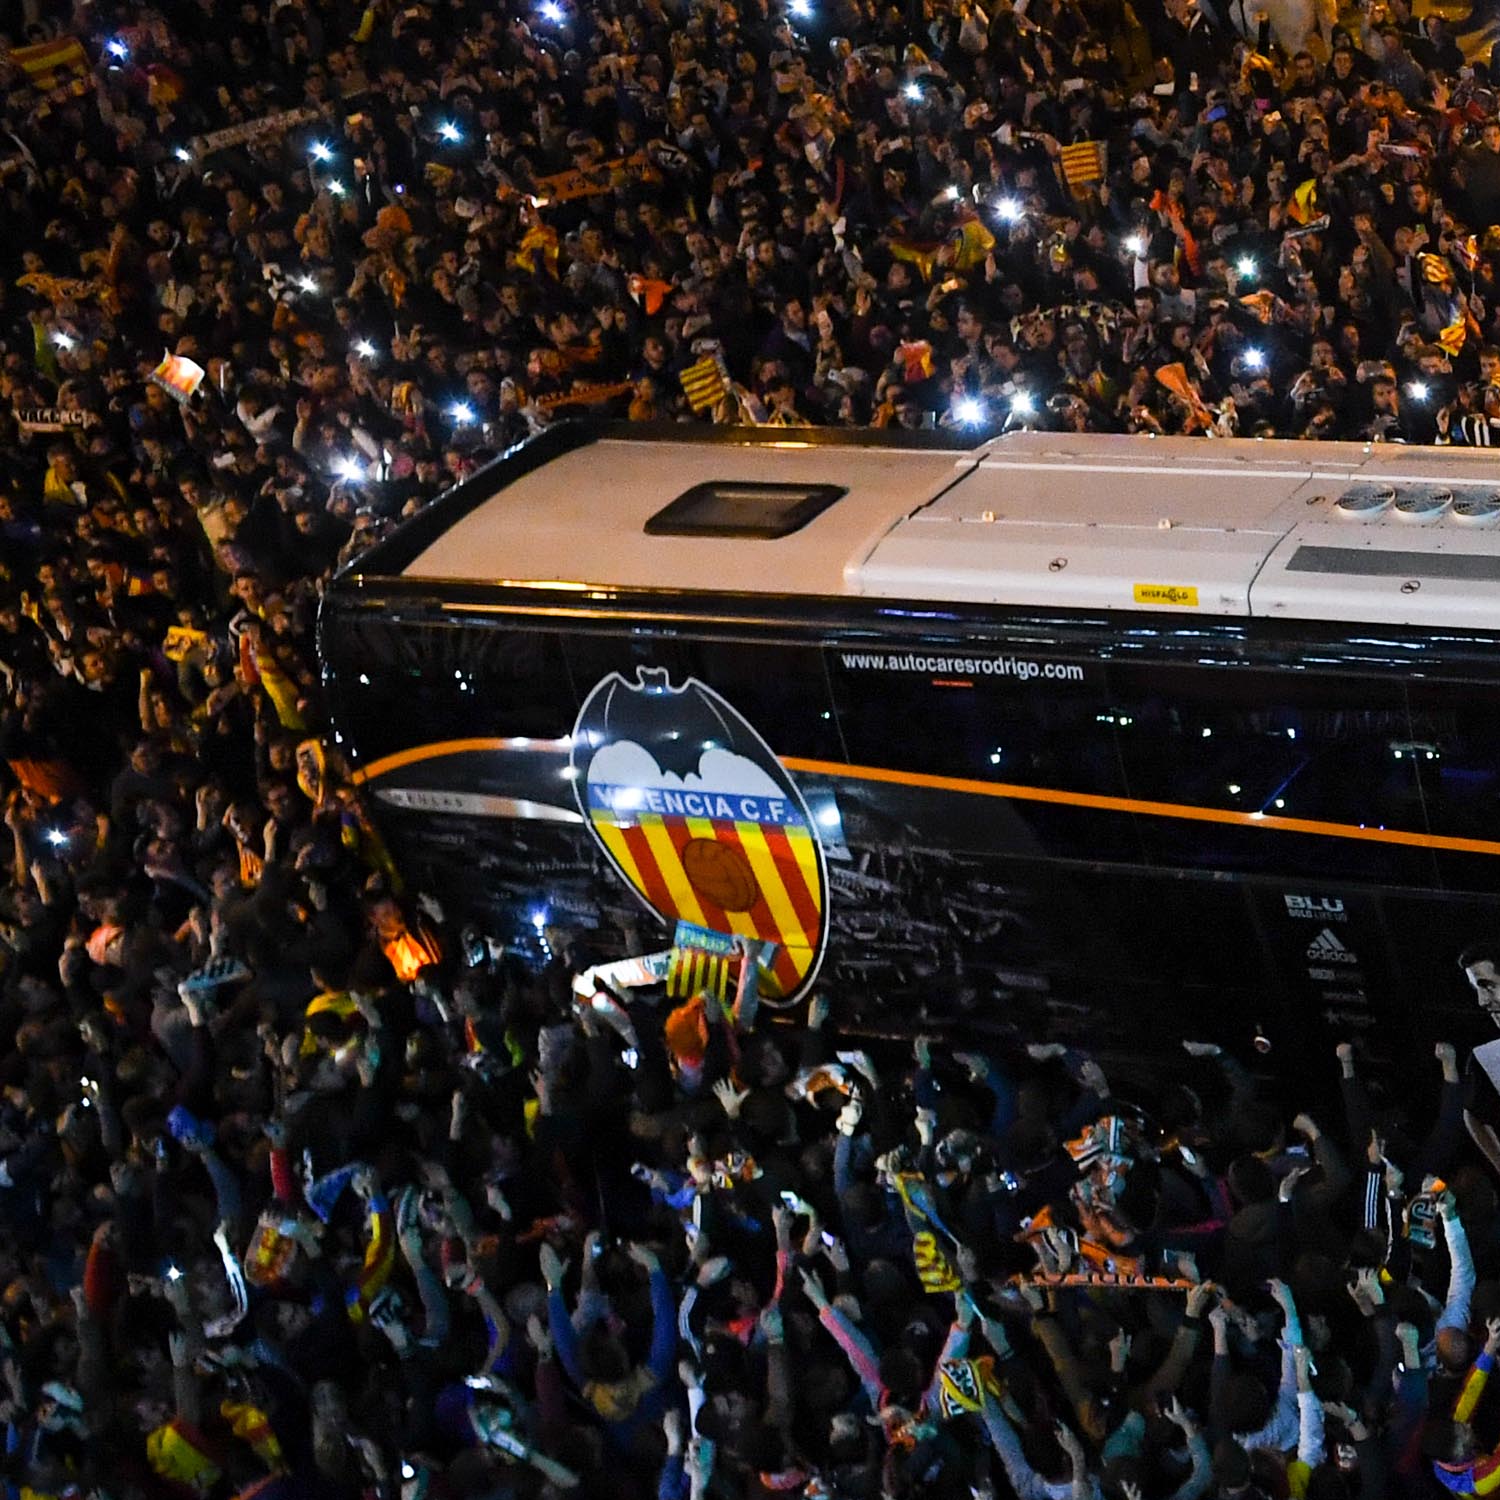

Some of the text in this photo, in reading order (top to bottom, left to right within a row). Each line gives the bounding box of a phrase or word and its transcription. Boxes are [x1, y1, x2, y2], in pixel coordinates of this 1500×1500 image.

[842, 654, 1085, 681] www.autocaresrodrigo.com
[741, 802, 795, 824] C.F.
[1284, 895, 1344, 912] BLU
